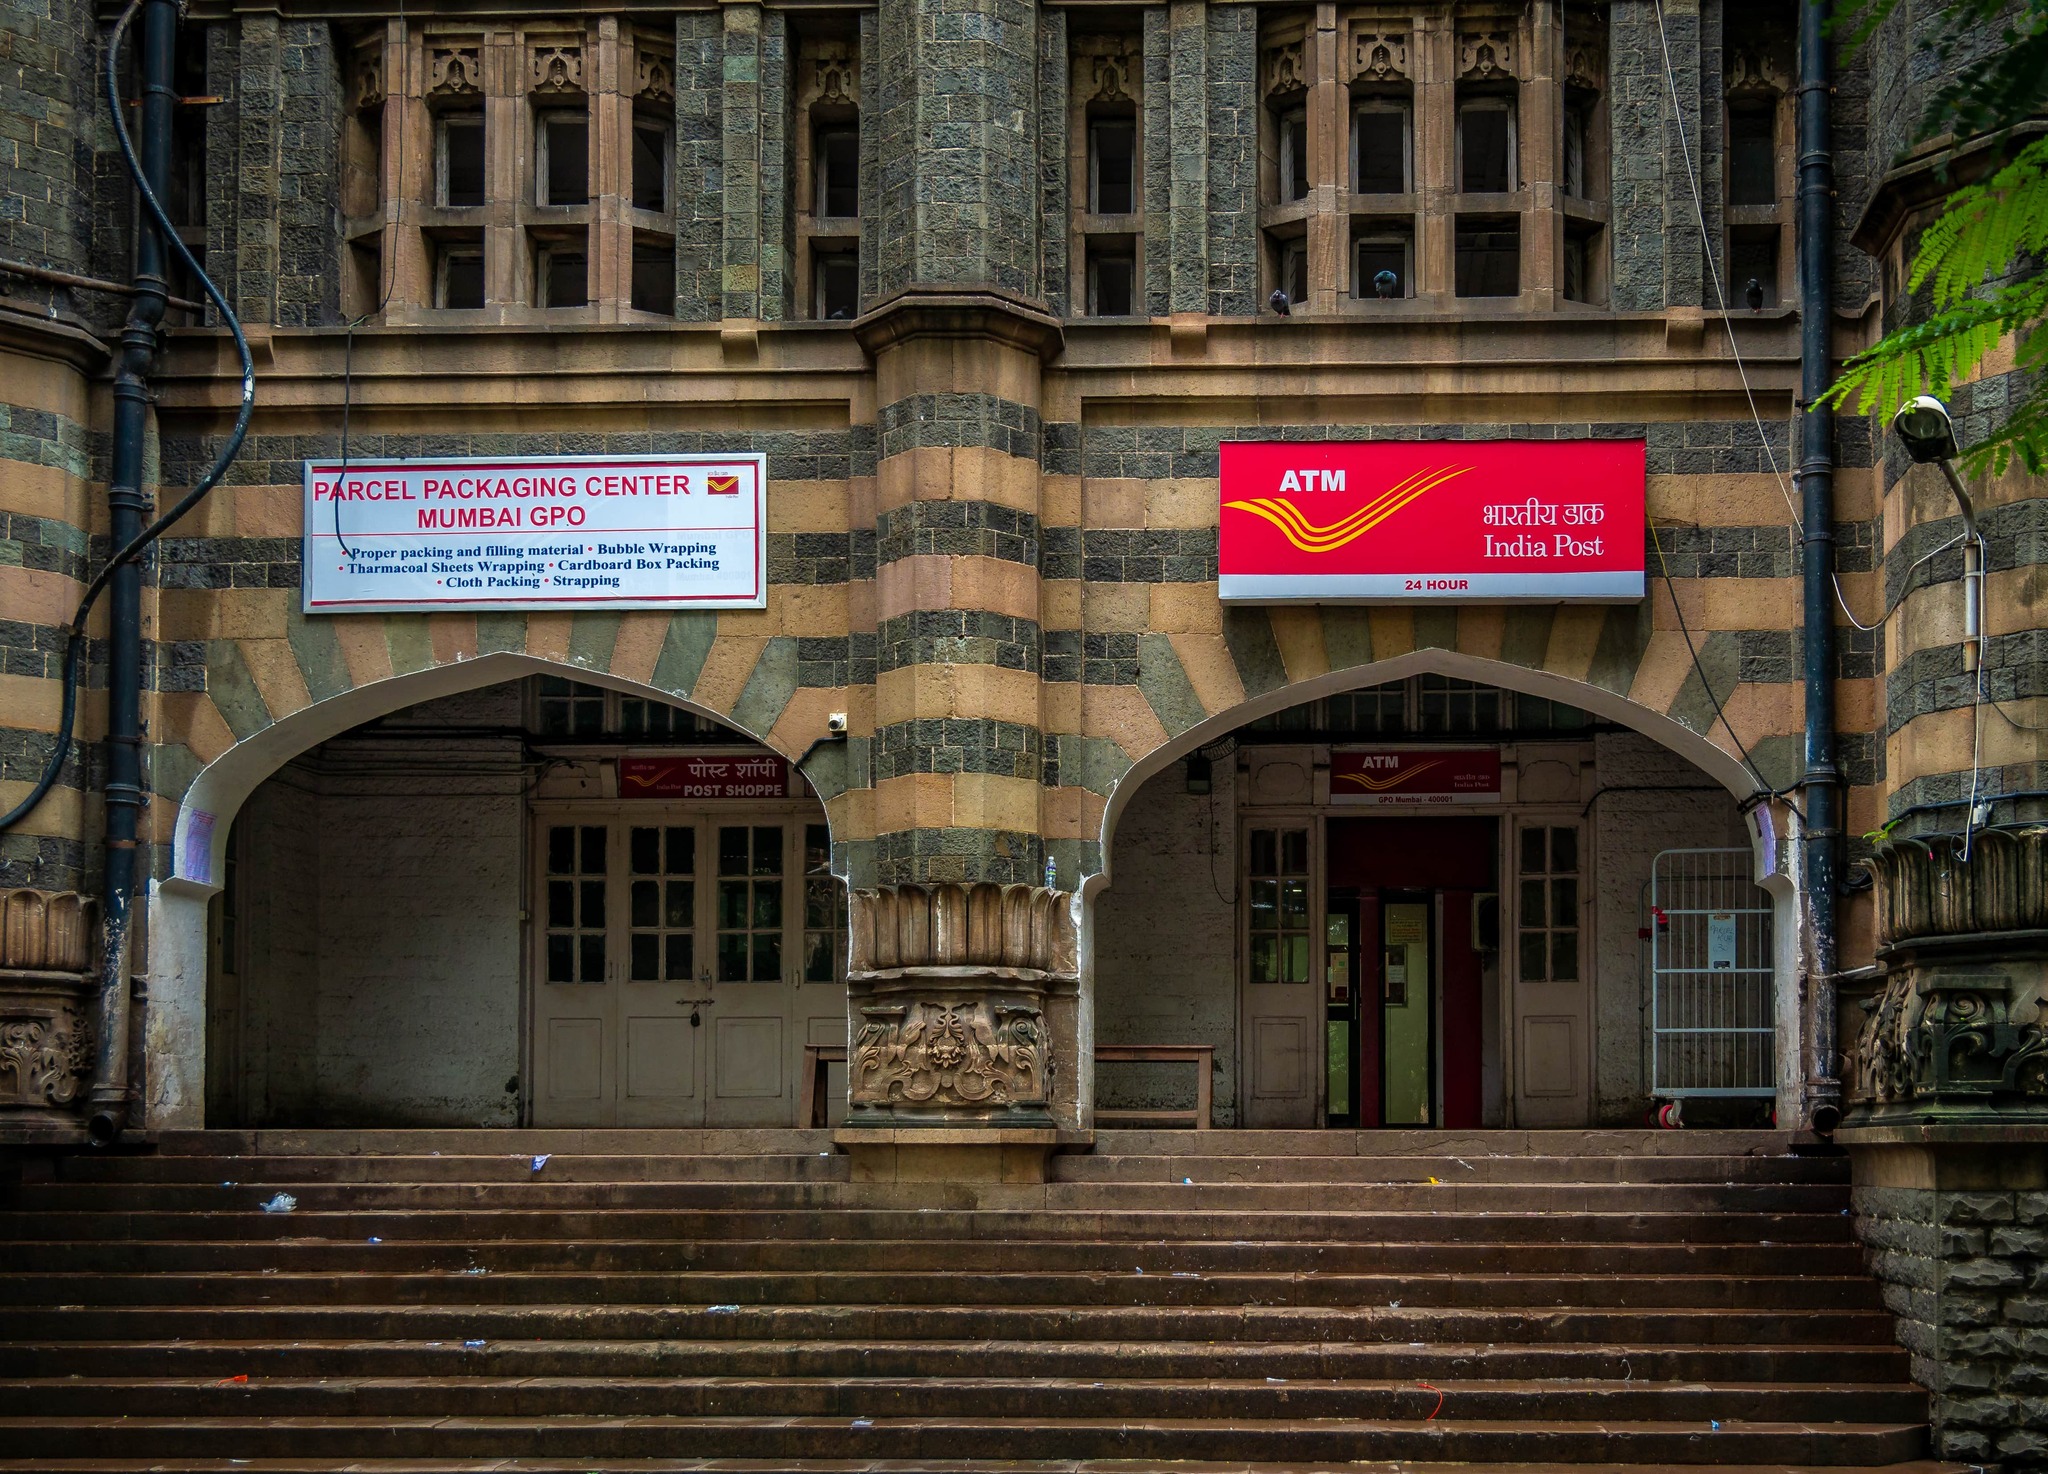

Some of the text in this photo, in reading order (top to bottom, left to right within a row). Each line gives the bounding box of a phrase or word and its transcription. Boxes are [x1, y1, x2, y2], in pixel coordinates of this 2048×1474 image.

[314, 474, 690, 501] PARCEL PACKAGING CENTER
[1279, 470, 1346, 492] ATM
[418, 505, 587, 528] MUMBAI GPO
[1483, 497, 1605, 526] भारतीय डाक
[351, 541, 716, 561] Proper packing and filling material Bubble Wrapping
[1484, 535, 1605, 558] India Post
[347, 557, 719, 574] Tharmacoal Sheets Wrapping Cardboard Box Packing
[446, 574, 620, 589] Cloth Packing Strapping
[1405, 579, 1468, 591] 24 HOUR
[688, 758, 777, 778] पोस्ट शॉपी
[1363, 756, 1398, 769] ATM
[684, 785, 782, 796] POST SHOPPE
